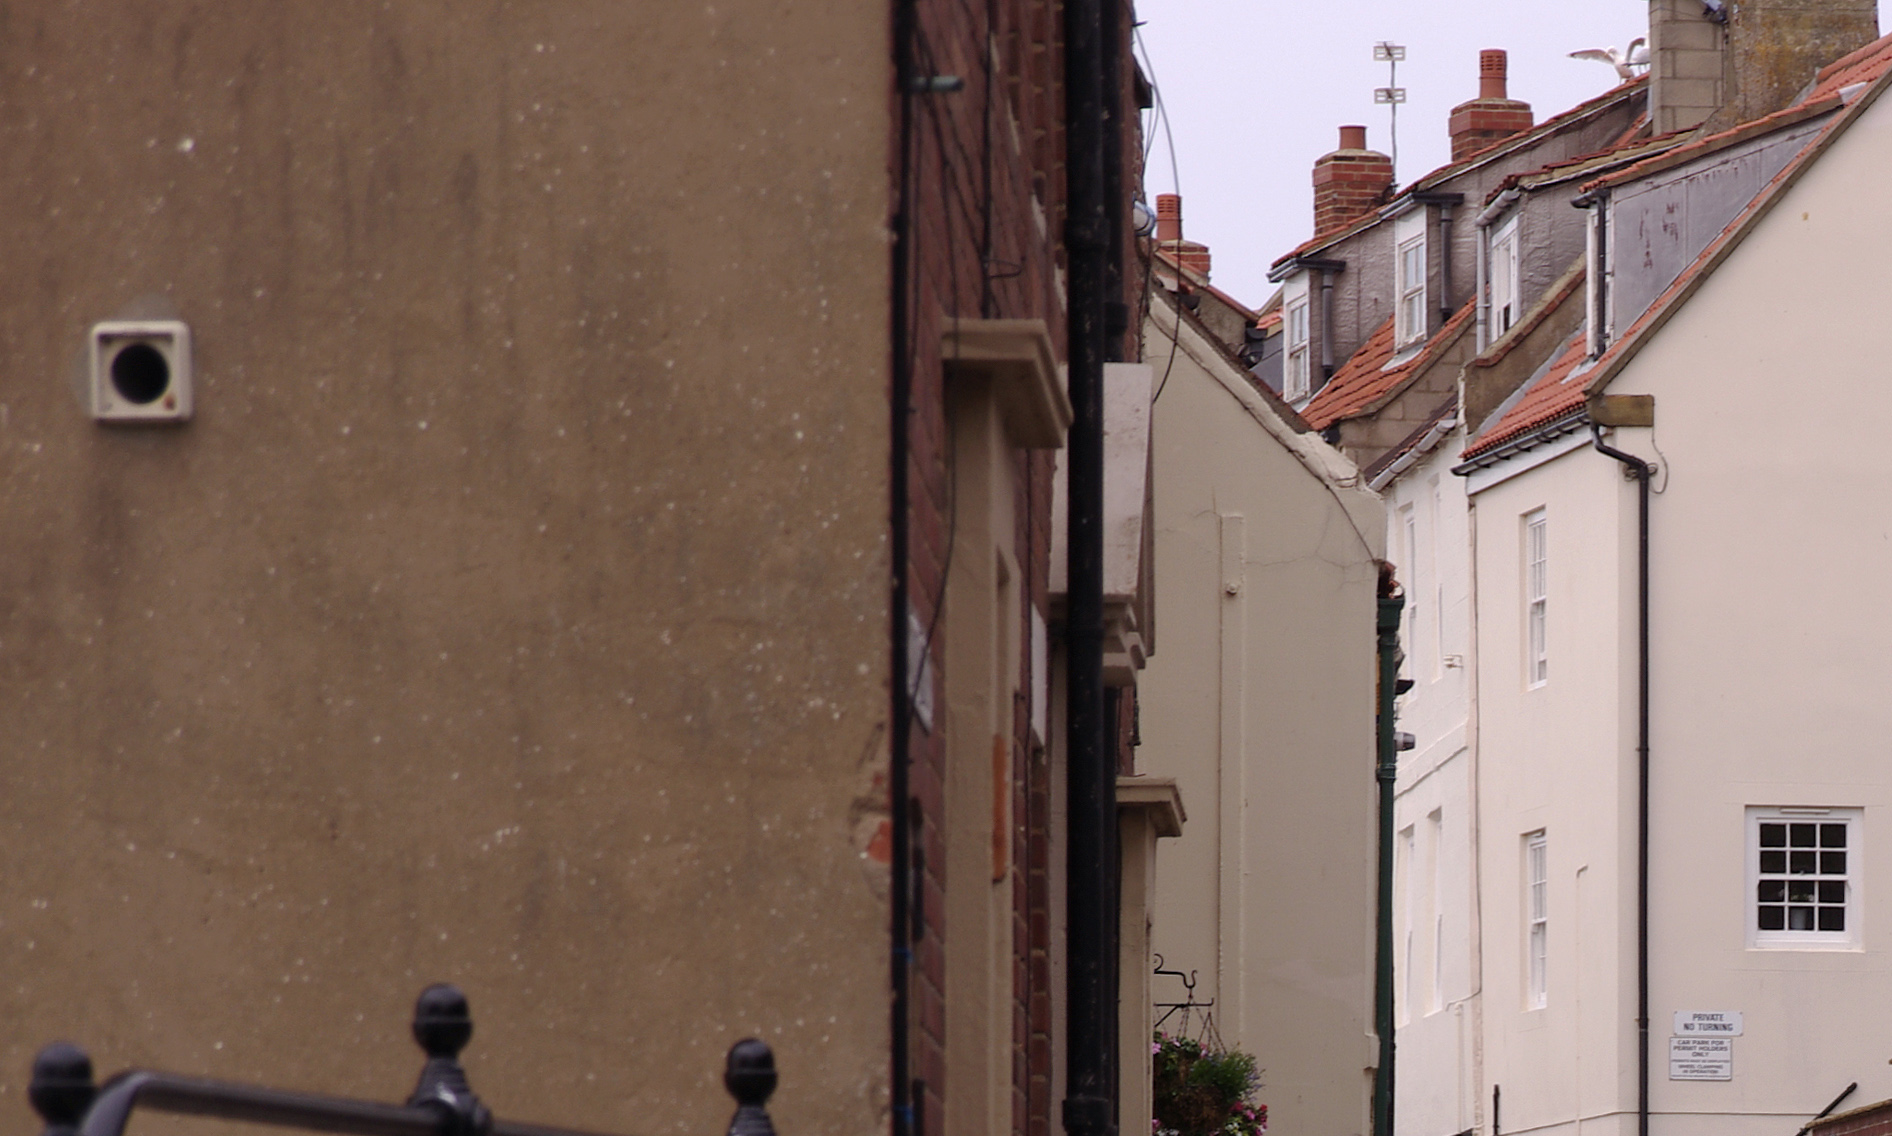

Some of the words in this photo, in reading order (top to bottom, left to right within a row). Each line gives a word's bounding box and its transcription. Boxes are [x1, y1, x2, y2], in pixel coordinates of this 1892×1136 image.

[1692, 1013, 1724, 1021] PRIVATE
[1683, 1023, 1695, 1031] NO
[1698, 1023, 1734, 1031] TURNING
